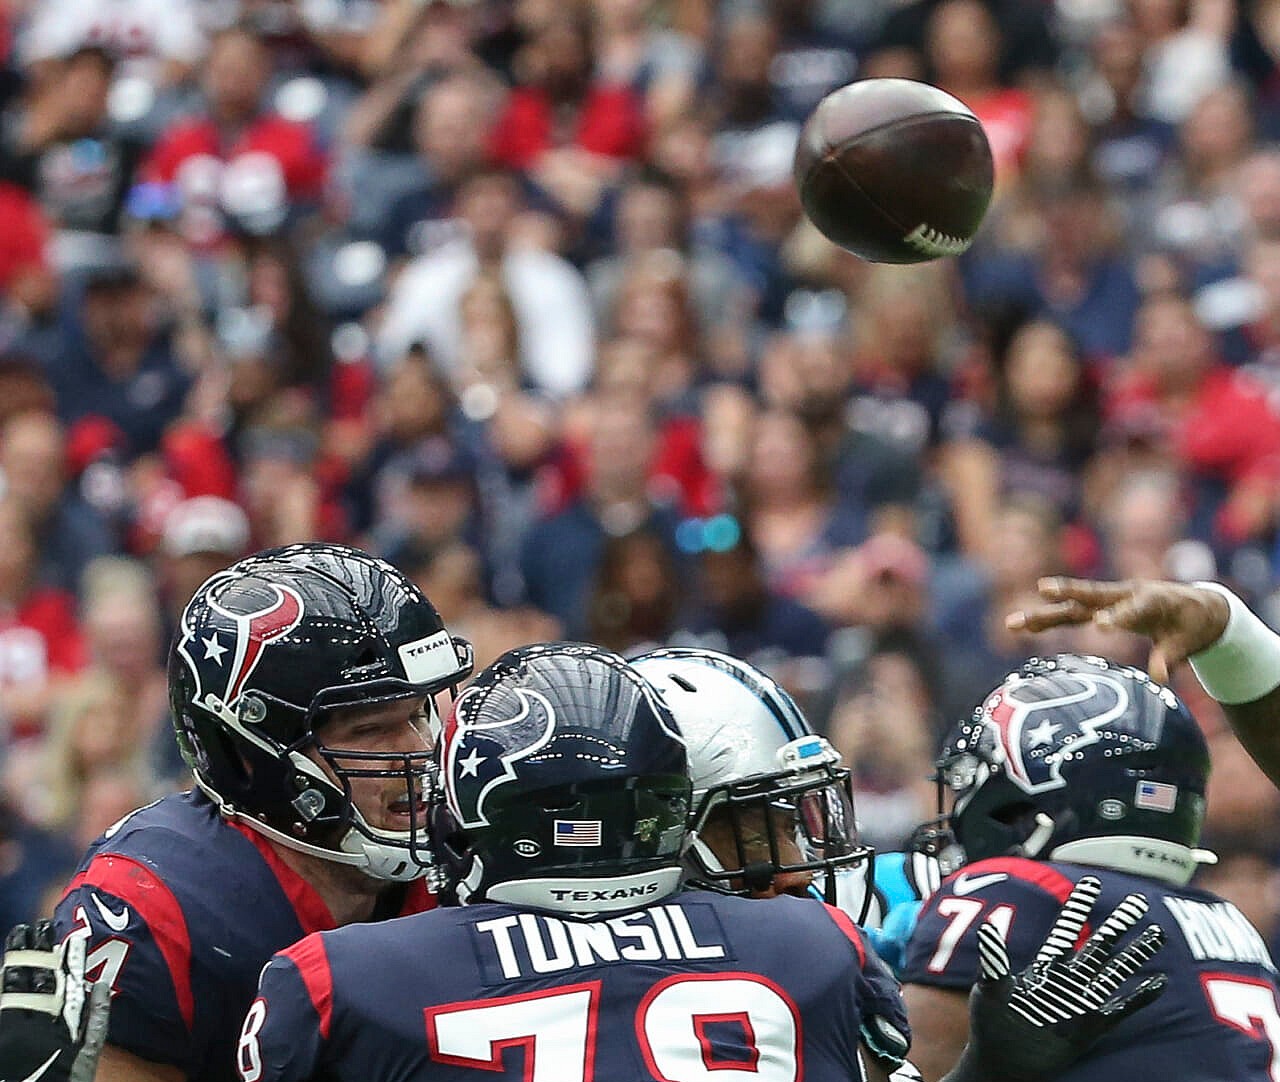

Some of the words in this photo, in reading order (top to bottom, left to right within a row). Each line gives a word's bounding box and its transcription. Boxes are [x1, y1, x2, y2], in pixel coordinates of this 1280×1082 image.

[406, 637, 449, 657] TEXANS
[550, 882, 659, 901] TEXANS
[475, 904, 726, 980] TUNSIL
